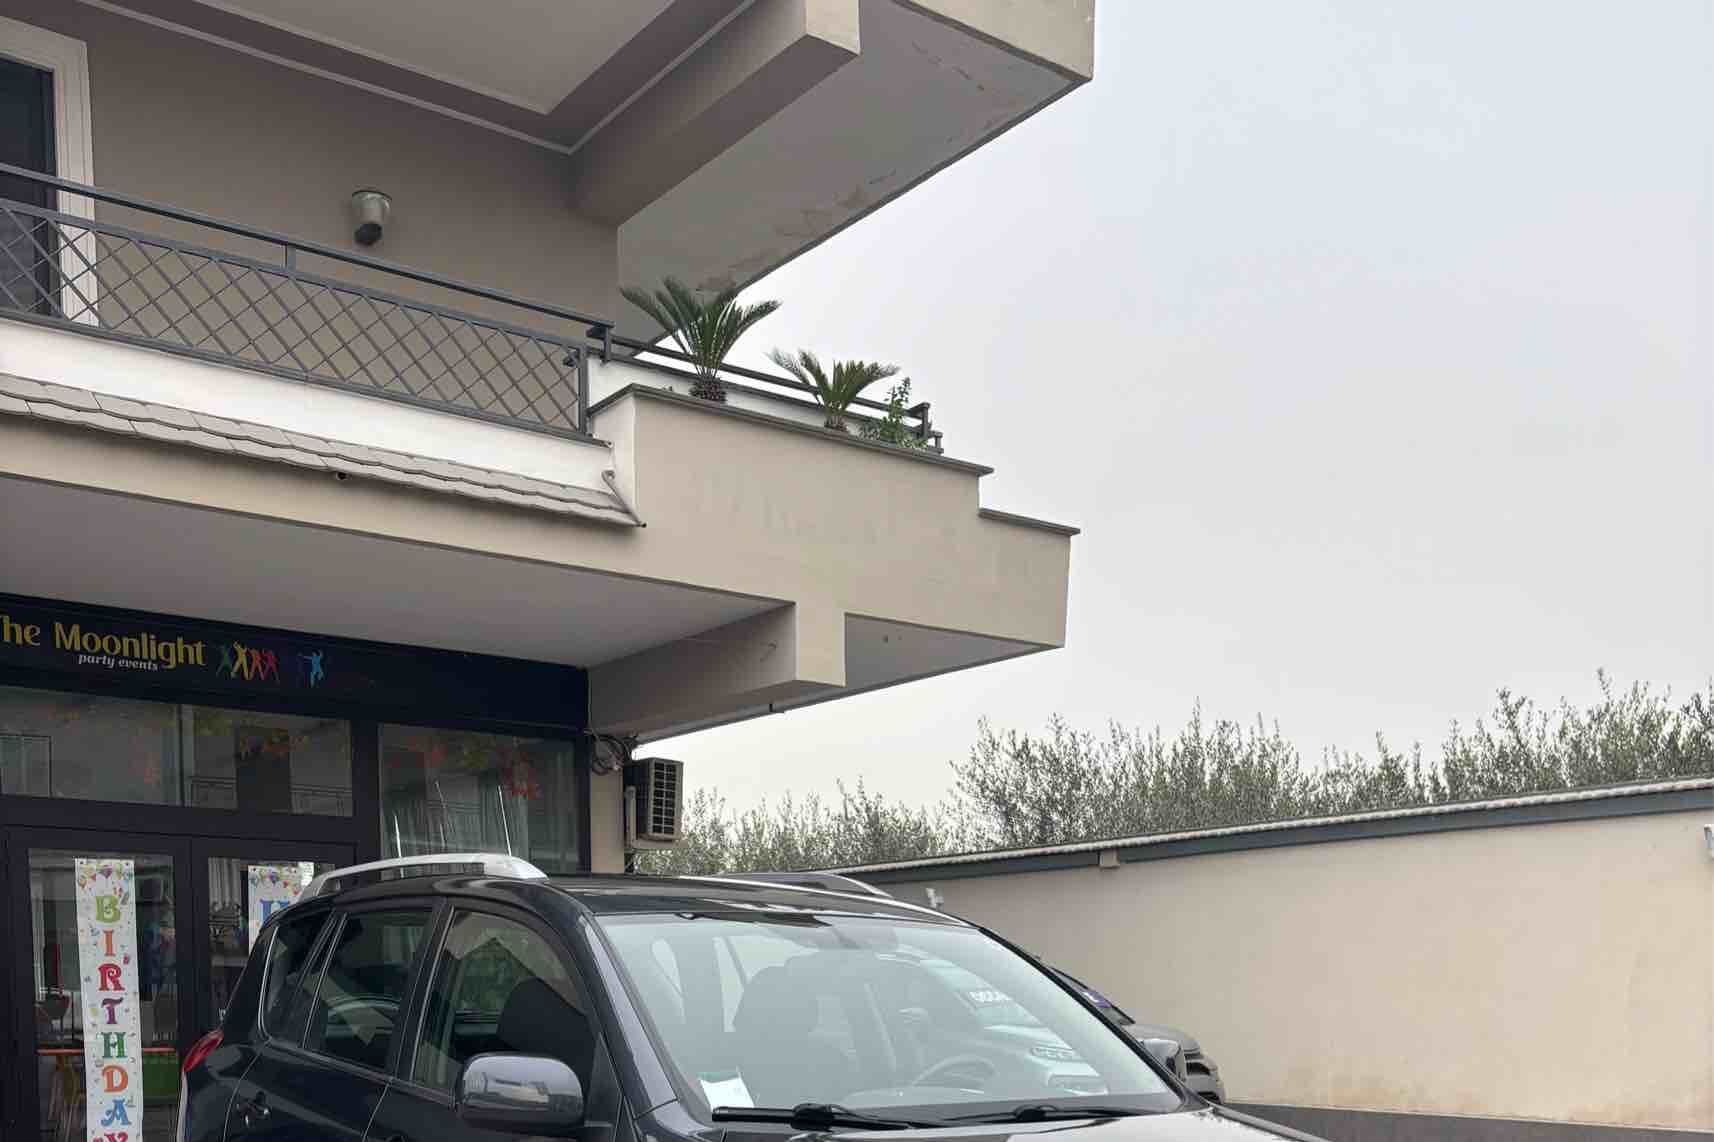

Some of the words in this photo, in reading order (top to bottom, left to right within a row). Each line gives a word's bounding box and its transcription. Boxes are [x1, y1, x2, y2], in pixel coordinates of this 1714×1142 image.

[55, 622, 206, 669] Moonlight
[78, 654, 115, 669] party
[118, 659, 159, 671] events
